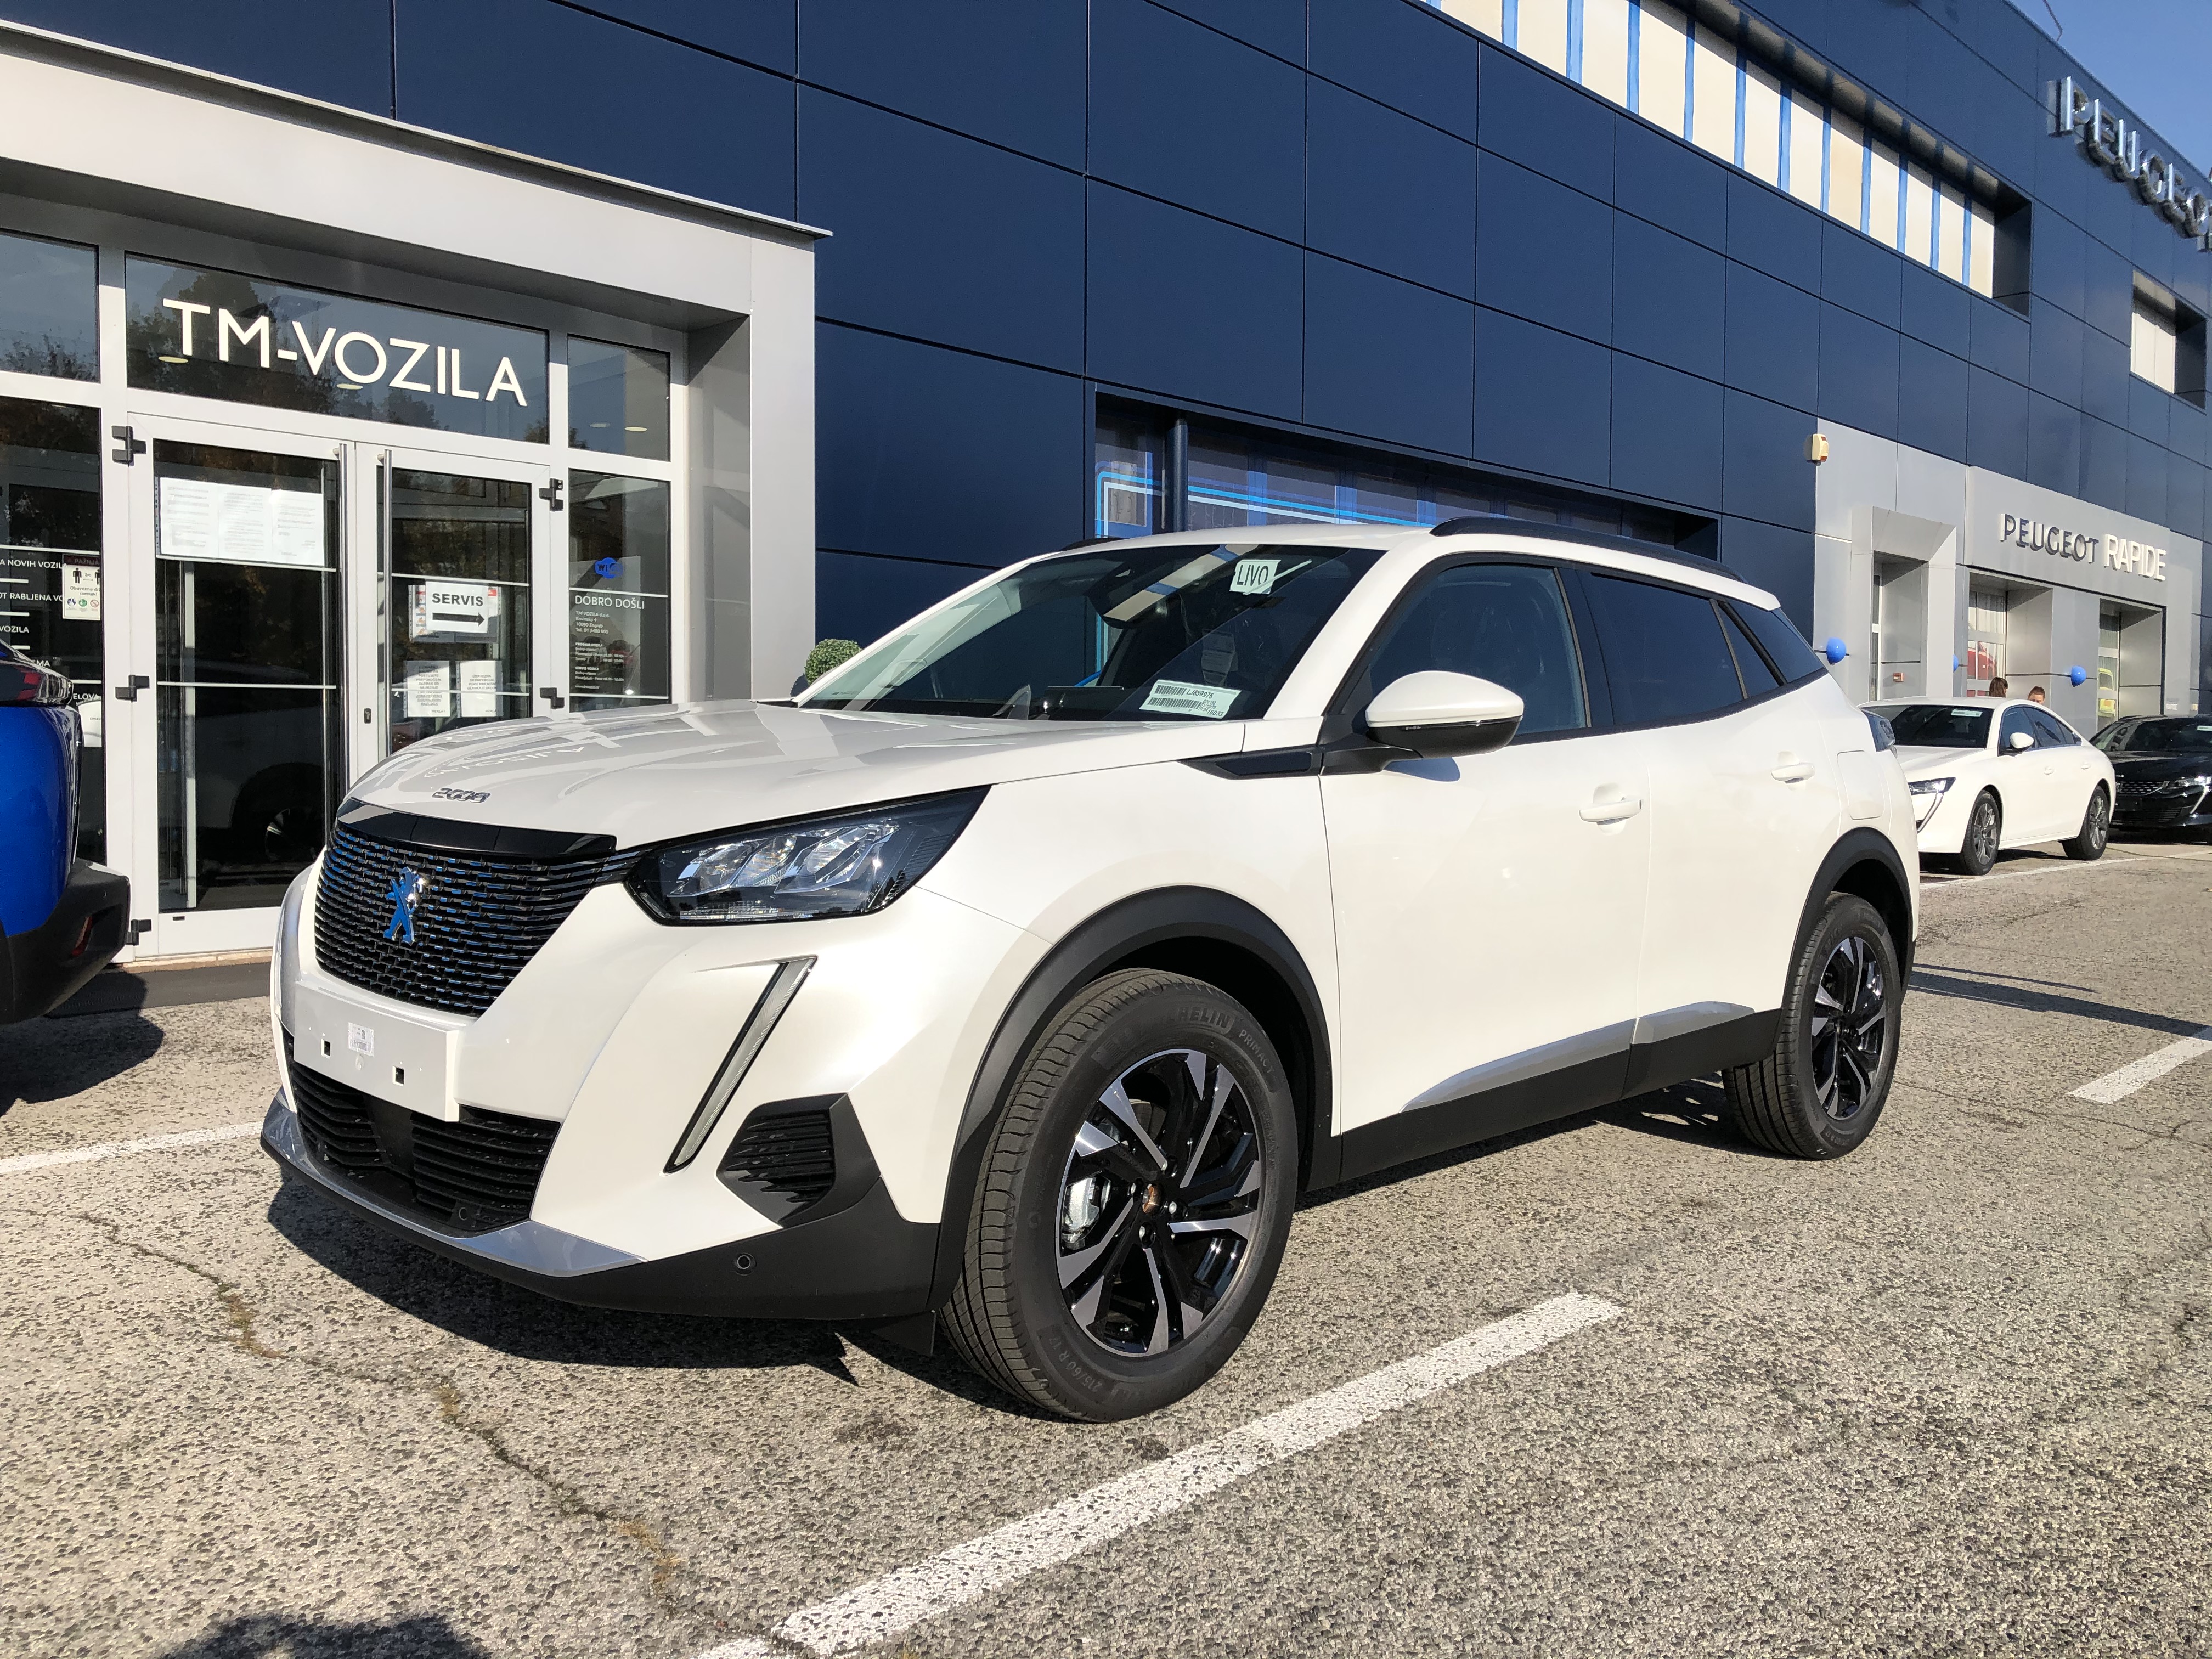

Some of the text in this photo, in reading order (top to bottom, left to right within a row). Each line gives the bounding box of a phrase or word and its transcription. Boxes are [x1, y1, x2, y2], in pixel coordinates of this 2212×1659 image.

[2049, 76, 2212, 241] PEUGEO
[163, 298, 527, 407] TM-VOZILA
[2000, 514, 2166, 581] PEUGEOT RAPIDE
[1237, 565, 1269, 586] LIVO
[10, 592, 52, 601] RABLJENA
[432, 593, 483, 607] SERVIS
[575, 595, 645, 610] DOBRO DOŠLI
[1186, 689, 1214, 699] LJ859976
[431, 788, 491, 804] 2008
[1238, 1029, 1275, 1074] PRIMACY
